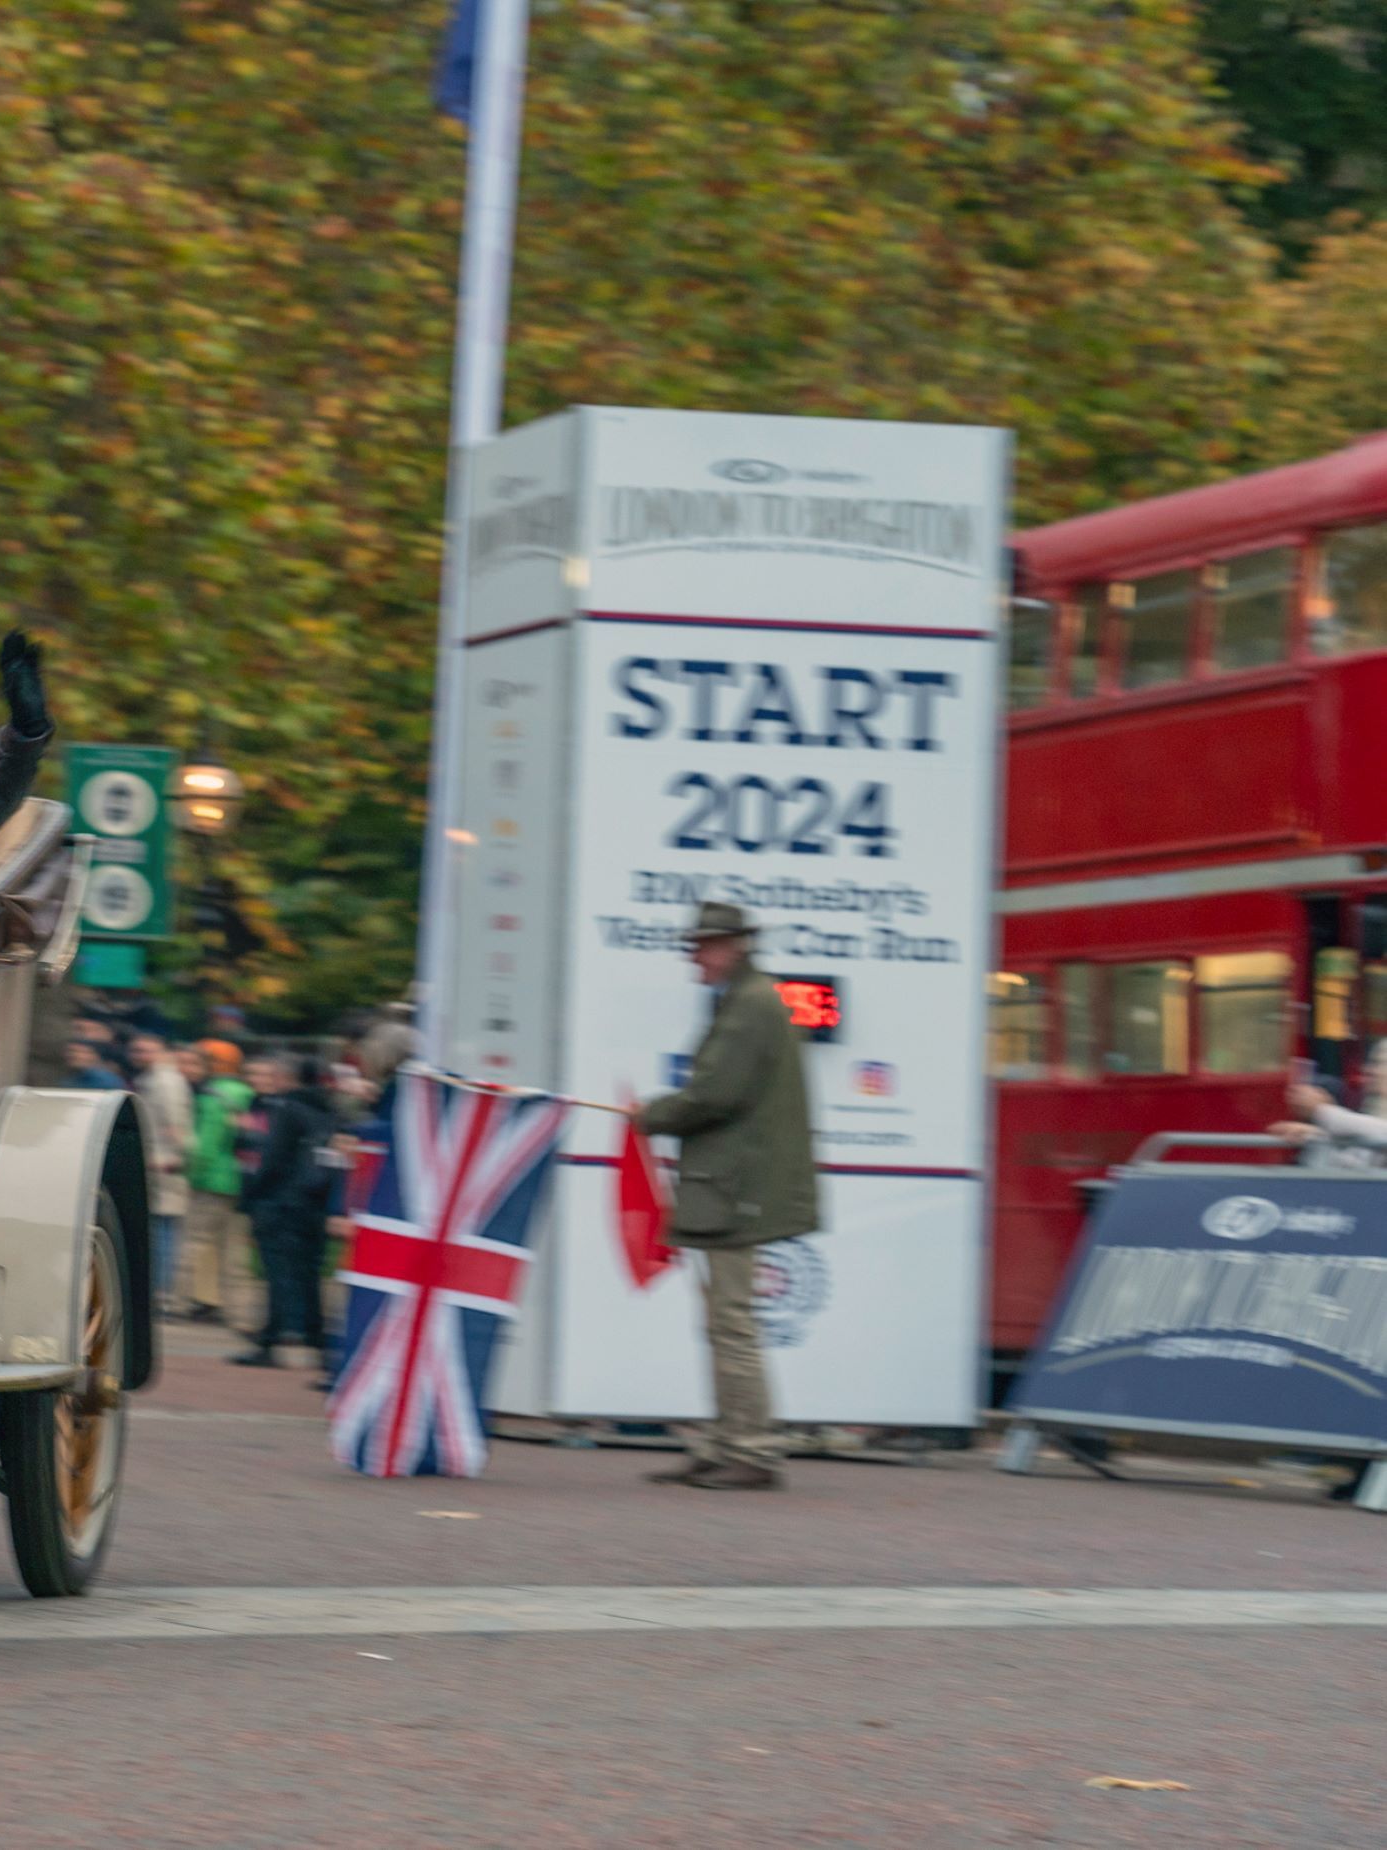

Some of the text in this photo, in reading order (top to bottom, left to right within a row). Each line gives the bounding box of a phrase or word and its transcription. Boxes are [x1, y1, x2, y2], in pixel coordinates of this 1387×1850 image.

[610, 656, 960, 752] START
[666, 772, 899, 859] 2024
[715, 873, 930, 922] Sotheby's
[777, 923, 863, 959] Car
[870, 926, 960, 963] Run
